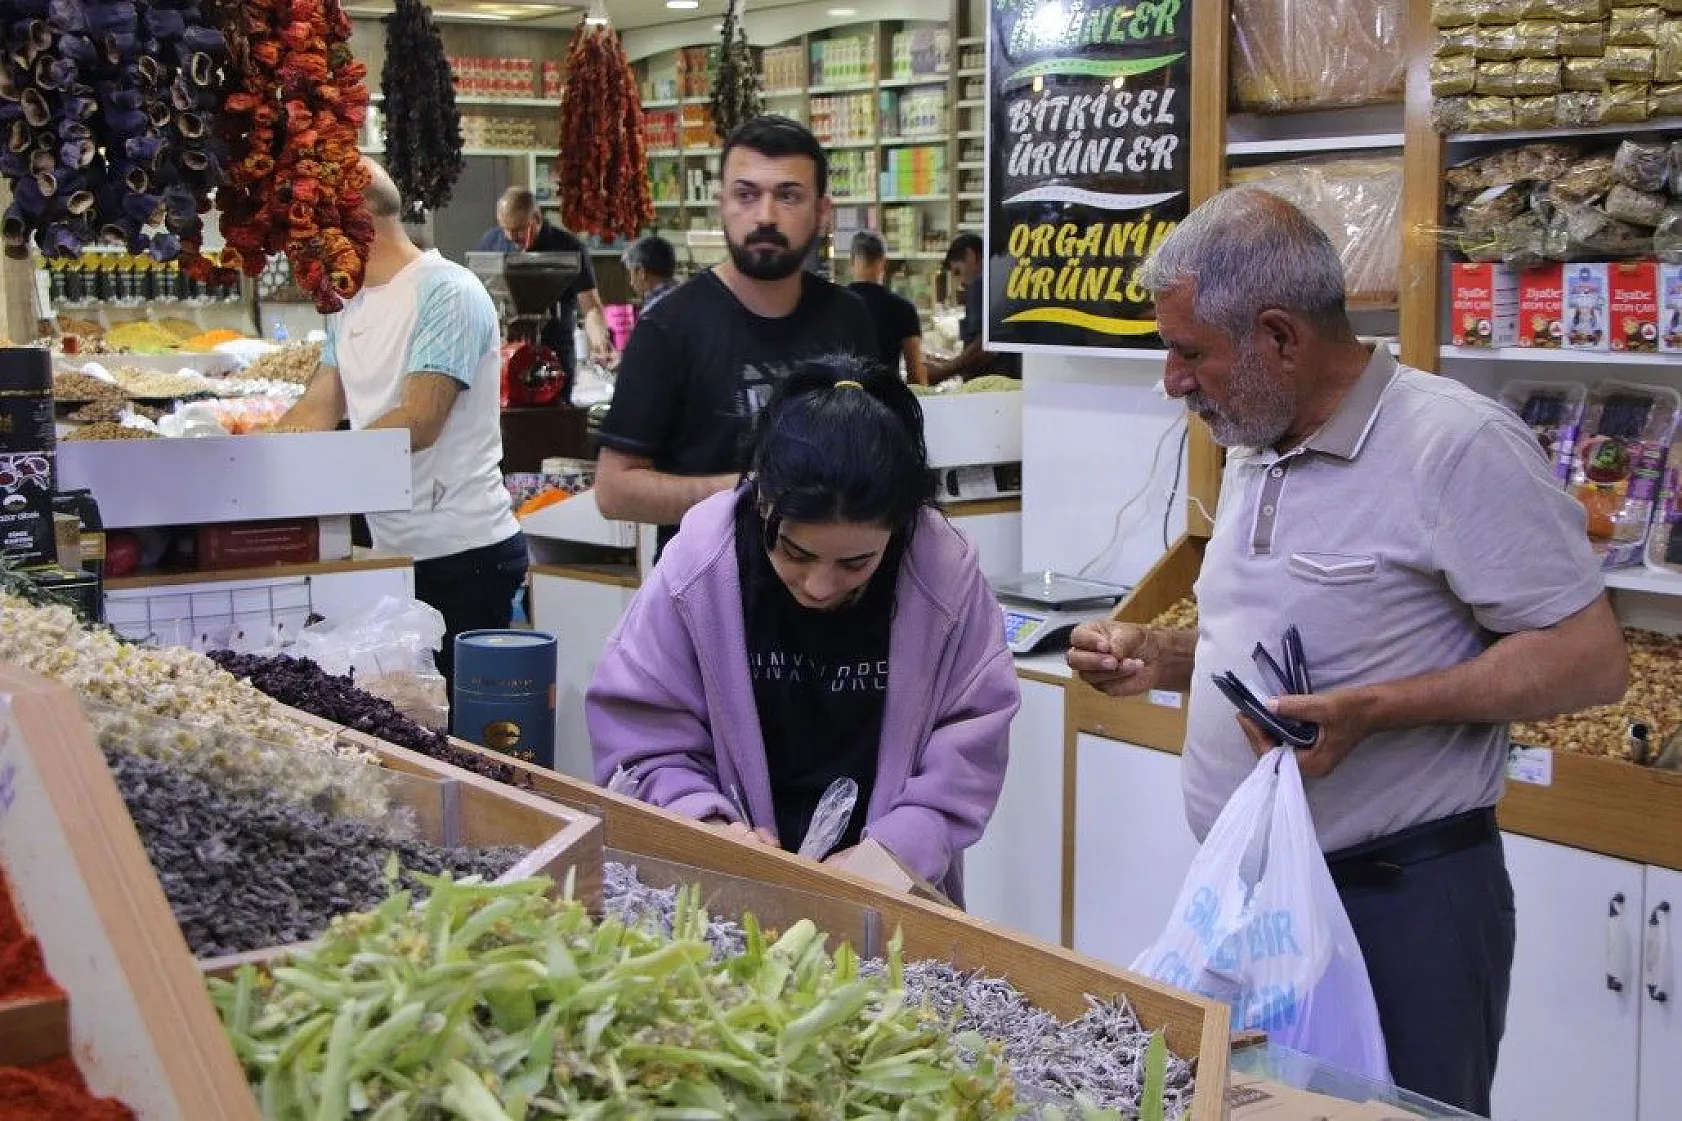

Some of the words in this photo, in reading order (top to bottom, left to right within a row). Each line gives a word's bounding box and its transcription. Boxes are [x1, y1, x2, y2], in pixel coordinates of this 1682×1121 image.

[1009, 0, 1180, 53] ÜÜNLER
[1007, 85, 1175, 133] BİTKİSEL
[1007, 131, 1179, 177] ÜRÜNLER
[1006, 257, 1155, 303] ÜRÜNLE
